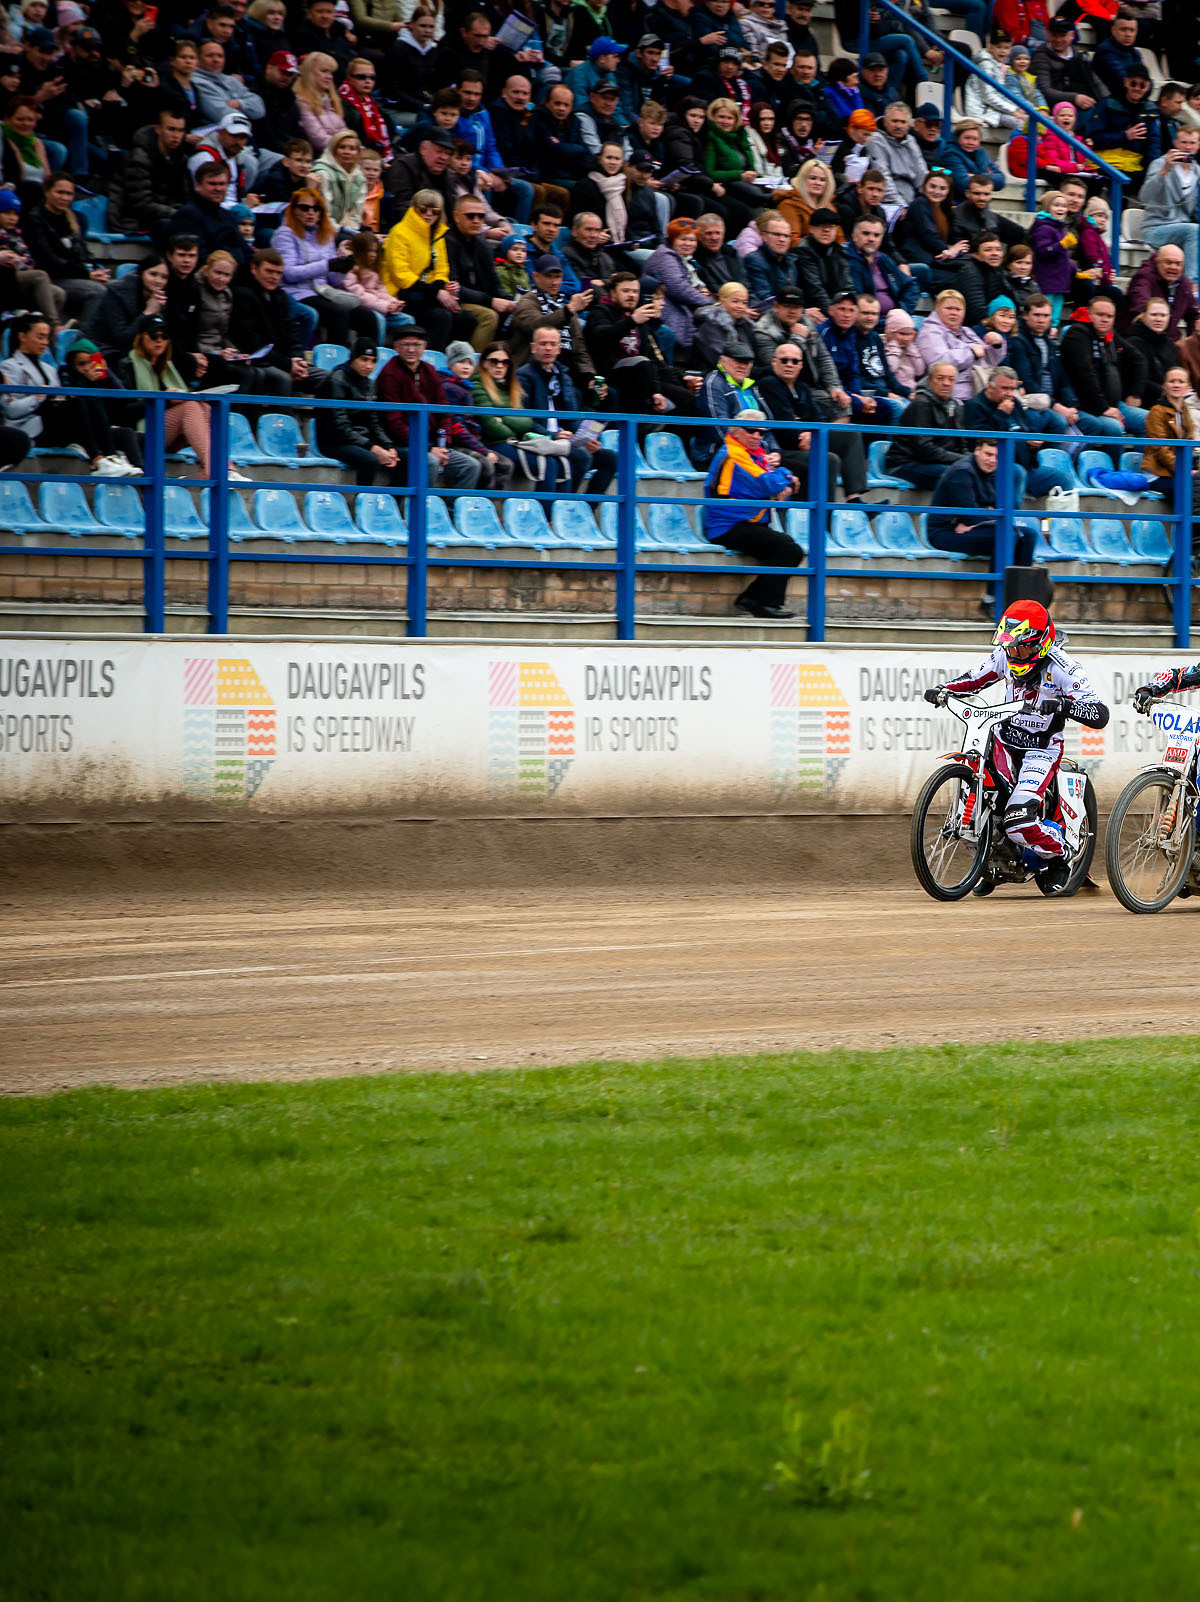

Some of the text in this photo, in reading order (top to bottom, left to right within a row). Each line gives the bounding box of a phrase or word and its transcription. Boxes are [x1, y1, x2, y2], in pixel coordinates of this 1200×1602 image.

[288, 662, 425, 699] DAUGAVPILS
[584, 665, 712, 701] DAUGAVPILS
[973, 709, 1003, 720] OPTIBET
[287, 716, 416, 752] IS SPEEDWAY
[585, 717, 679, 751] IR SPORTS
[860, 717, 876, 751] IS
[1167, 748, 1188, 758] AMD
